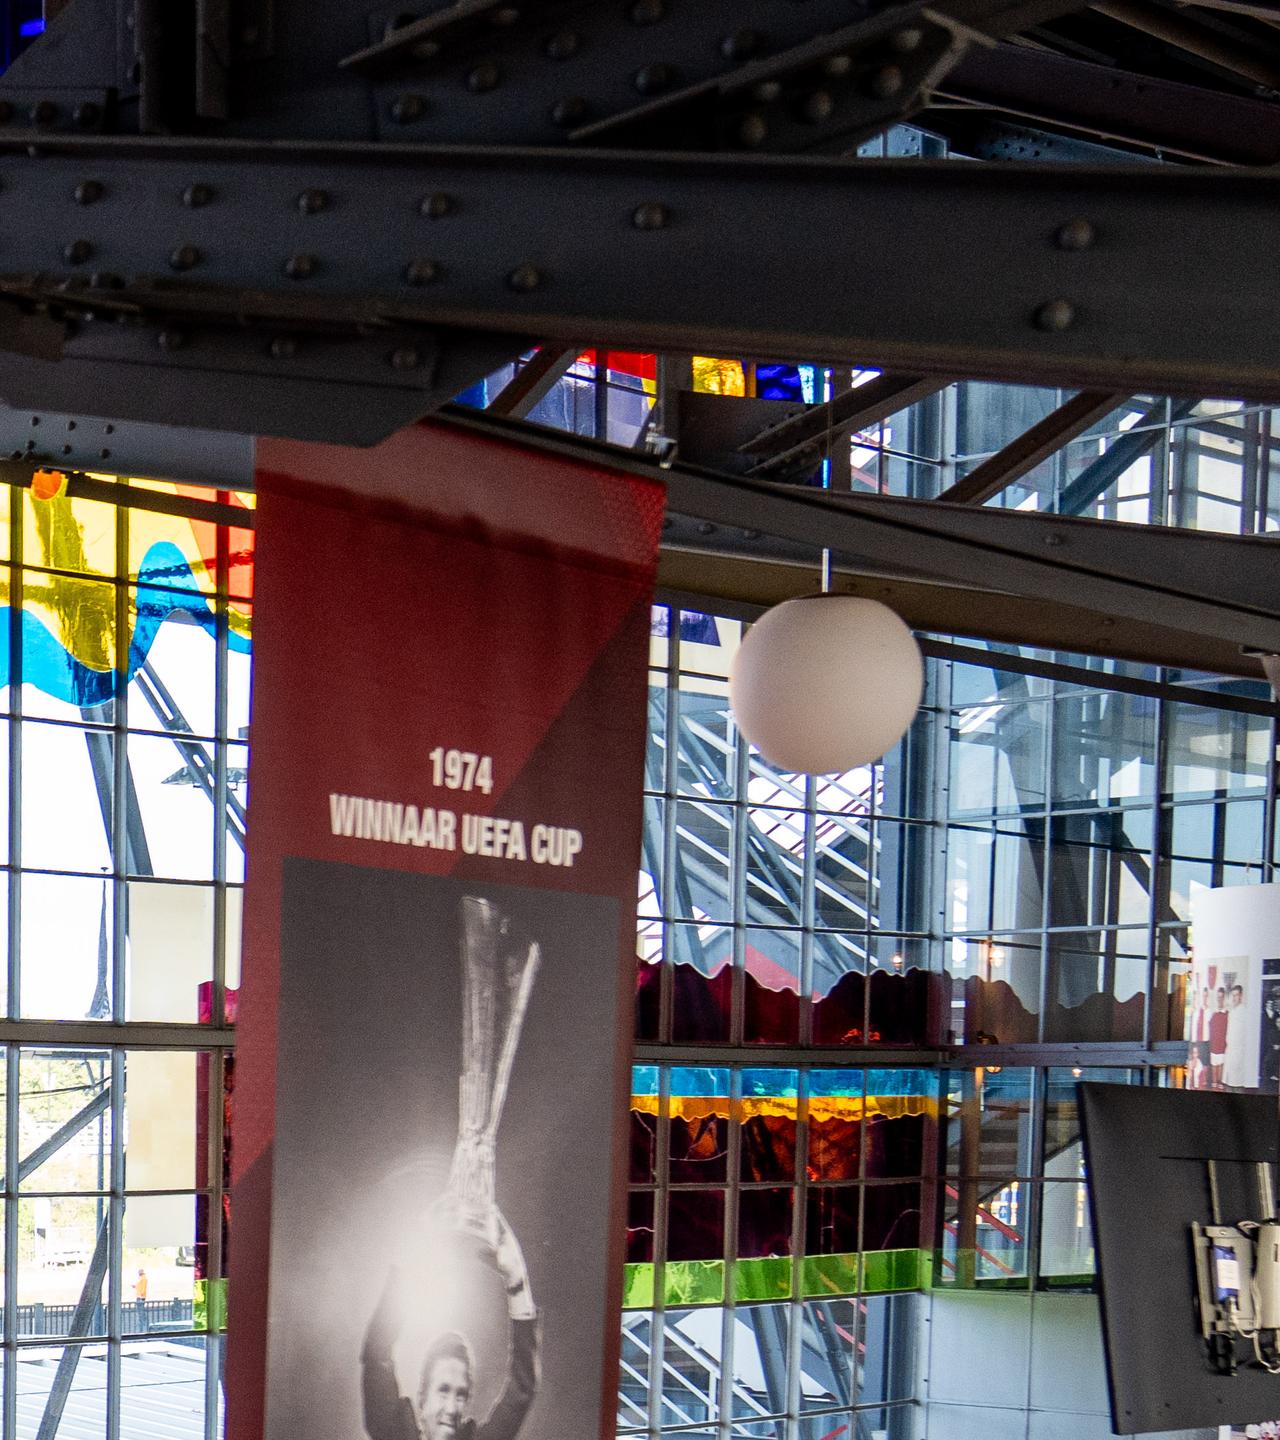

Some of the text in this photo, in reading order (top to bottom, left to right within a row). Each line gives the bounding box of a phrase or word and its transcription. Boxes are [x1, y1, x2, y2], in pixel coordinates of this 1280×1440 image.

[429, 747, 493, 794] 1974
[329, 794, 582, 867] WINNAAR UEFA CUP
